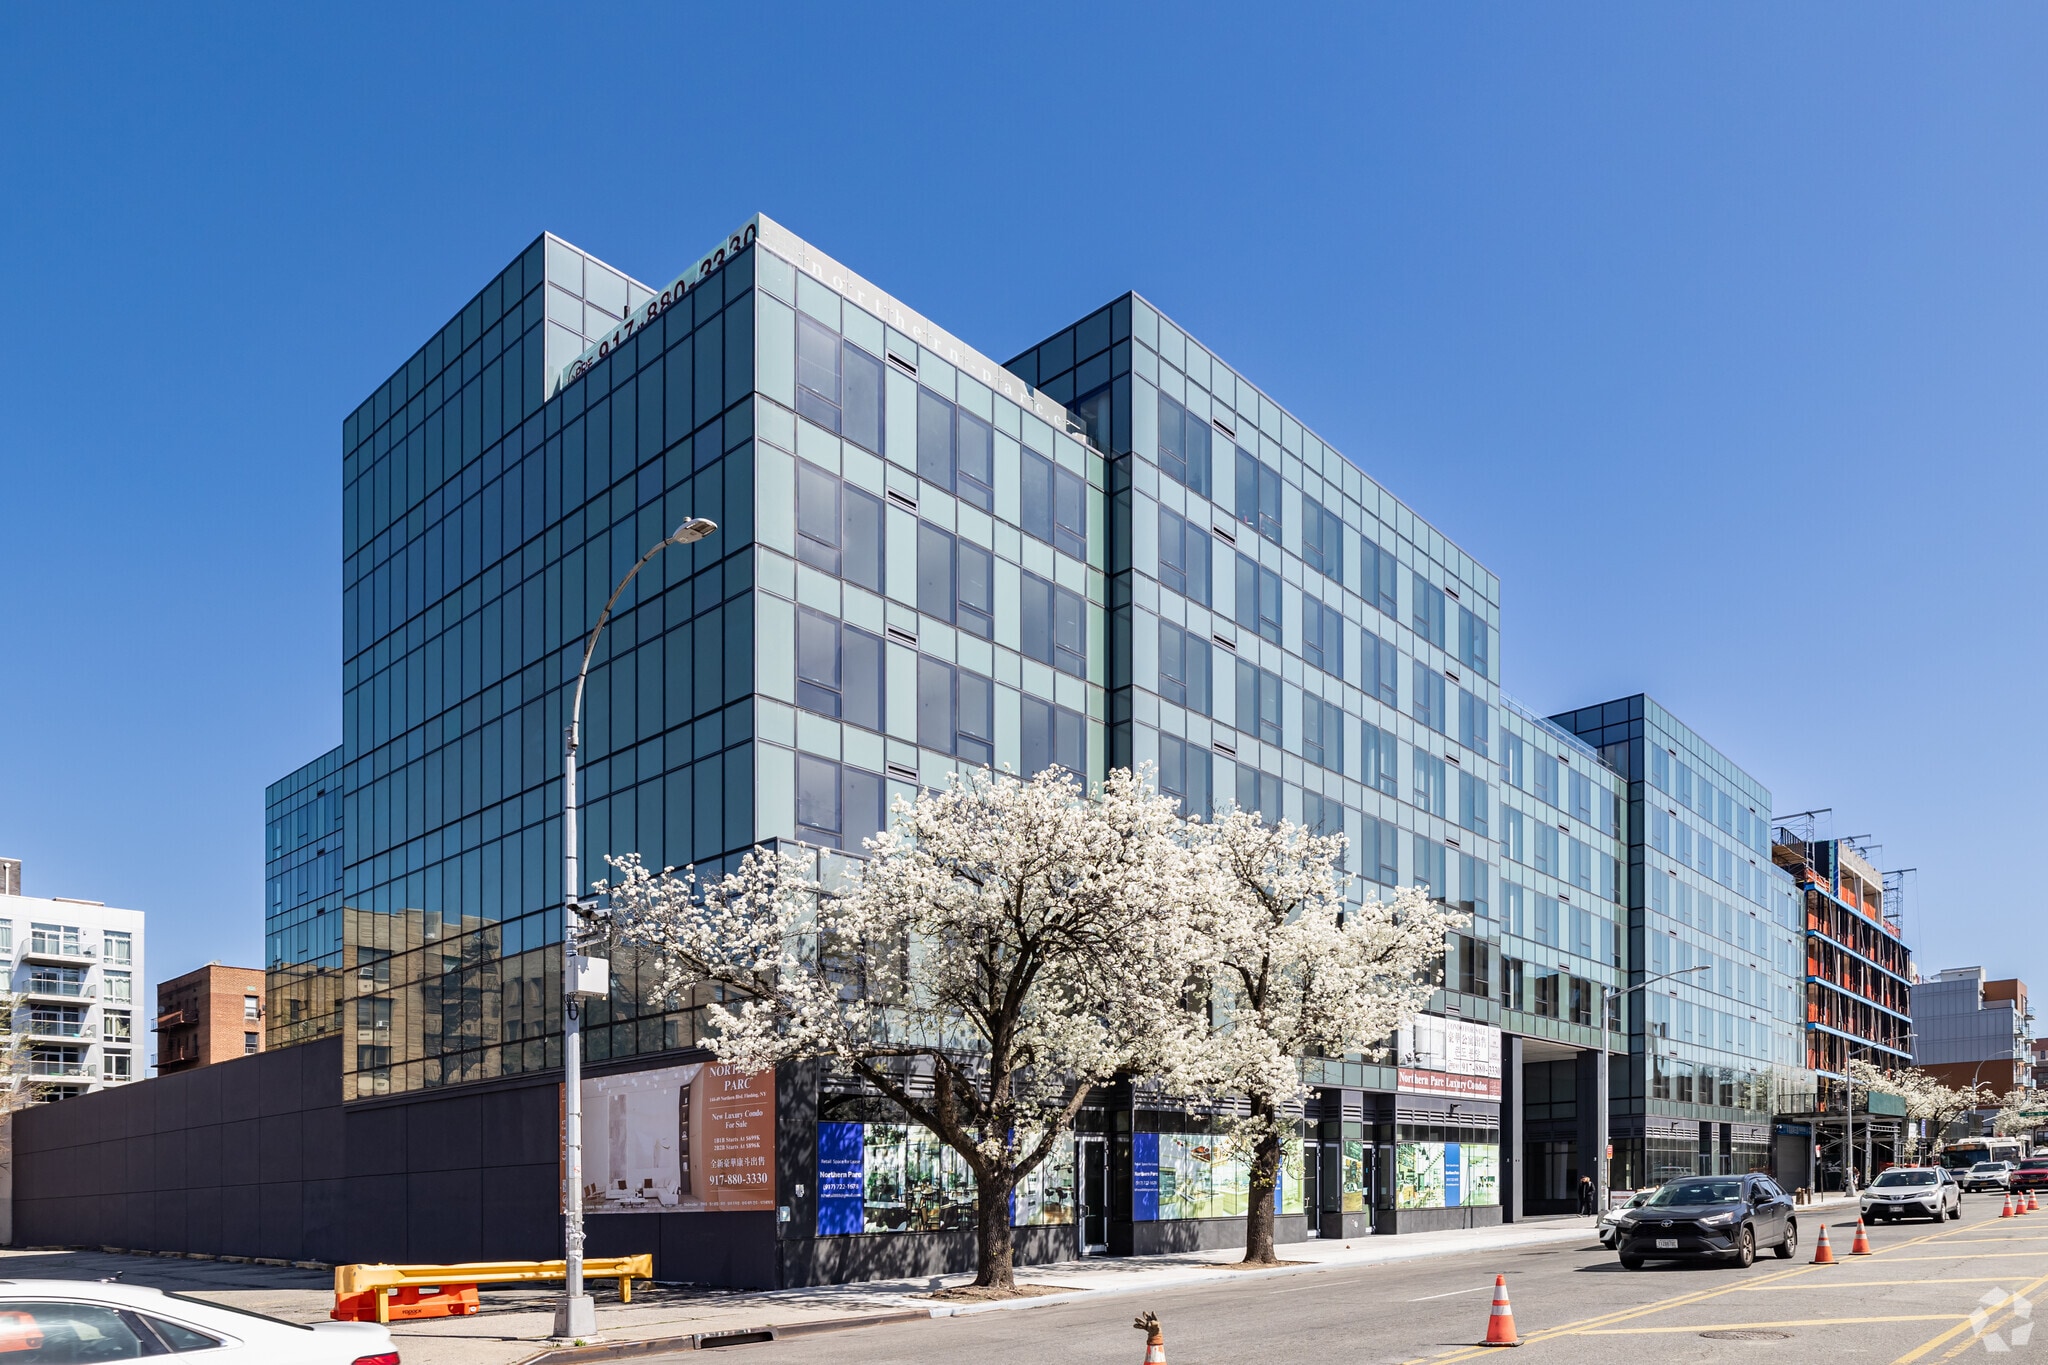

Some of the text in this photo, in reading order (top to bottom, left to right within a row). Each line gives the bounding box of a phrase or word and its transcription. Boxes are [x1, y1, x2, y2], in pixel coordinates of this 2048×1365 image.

[724, 1078, 753, 1091] PARC
[1399, 1071, 1429, 1086] Northern
[1430, 1074, 1445, 1087] Parc
[1446, 1077, 1467, 1092] Luxury
[1467, 1080, 1488, 1091] Condos
[712, 1109, 763, 1121] New Luxury Condo
[725, 1120, 748, 1129] For Sale
[709, 1172, 768, 1186] 917-880-3330
